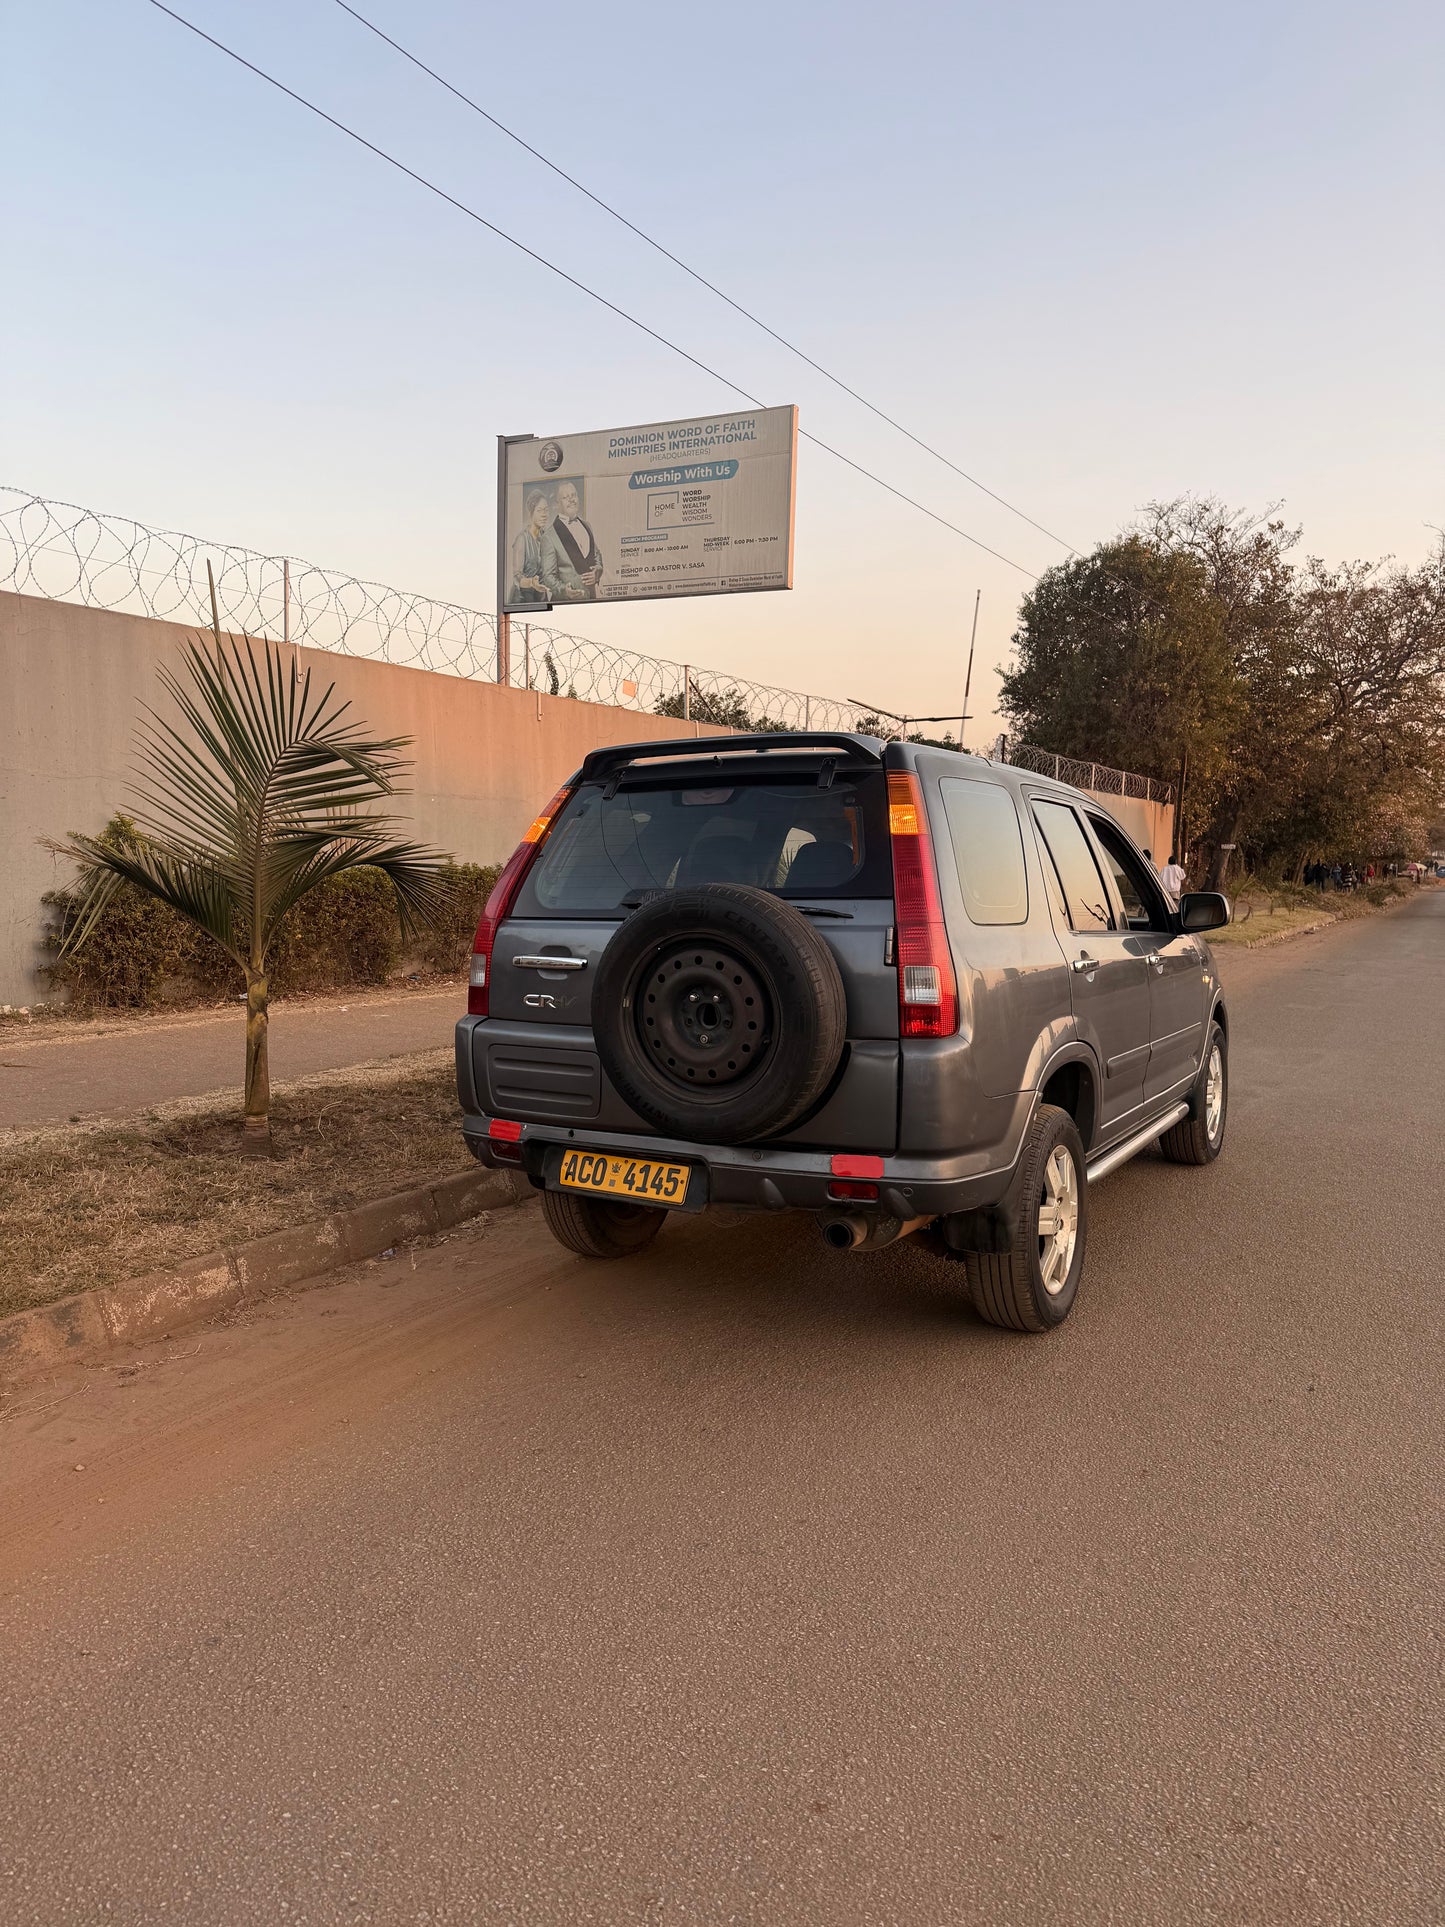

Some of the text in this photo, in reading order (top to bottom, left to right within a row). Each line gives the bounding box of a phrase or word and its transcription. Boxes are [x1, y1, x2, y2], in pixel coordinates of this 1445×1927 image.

[609, 420, 755, 448] DOMINION WORD OF FAITH
[608, 431, 757, 459] MINISTRIES INTERNATIONAL
[650, 448, 711, 462] (HEADQUARTERS)
[635, 464, 730, 485] Worship With Us
[655, 503, 675, 511] HOME
[683, 495, 711, 503] WORSHIP
[682, 514, 712, 522] WONDERS
[623, 1162, 681, 1196] 4145
